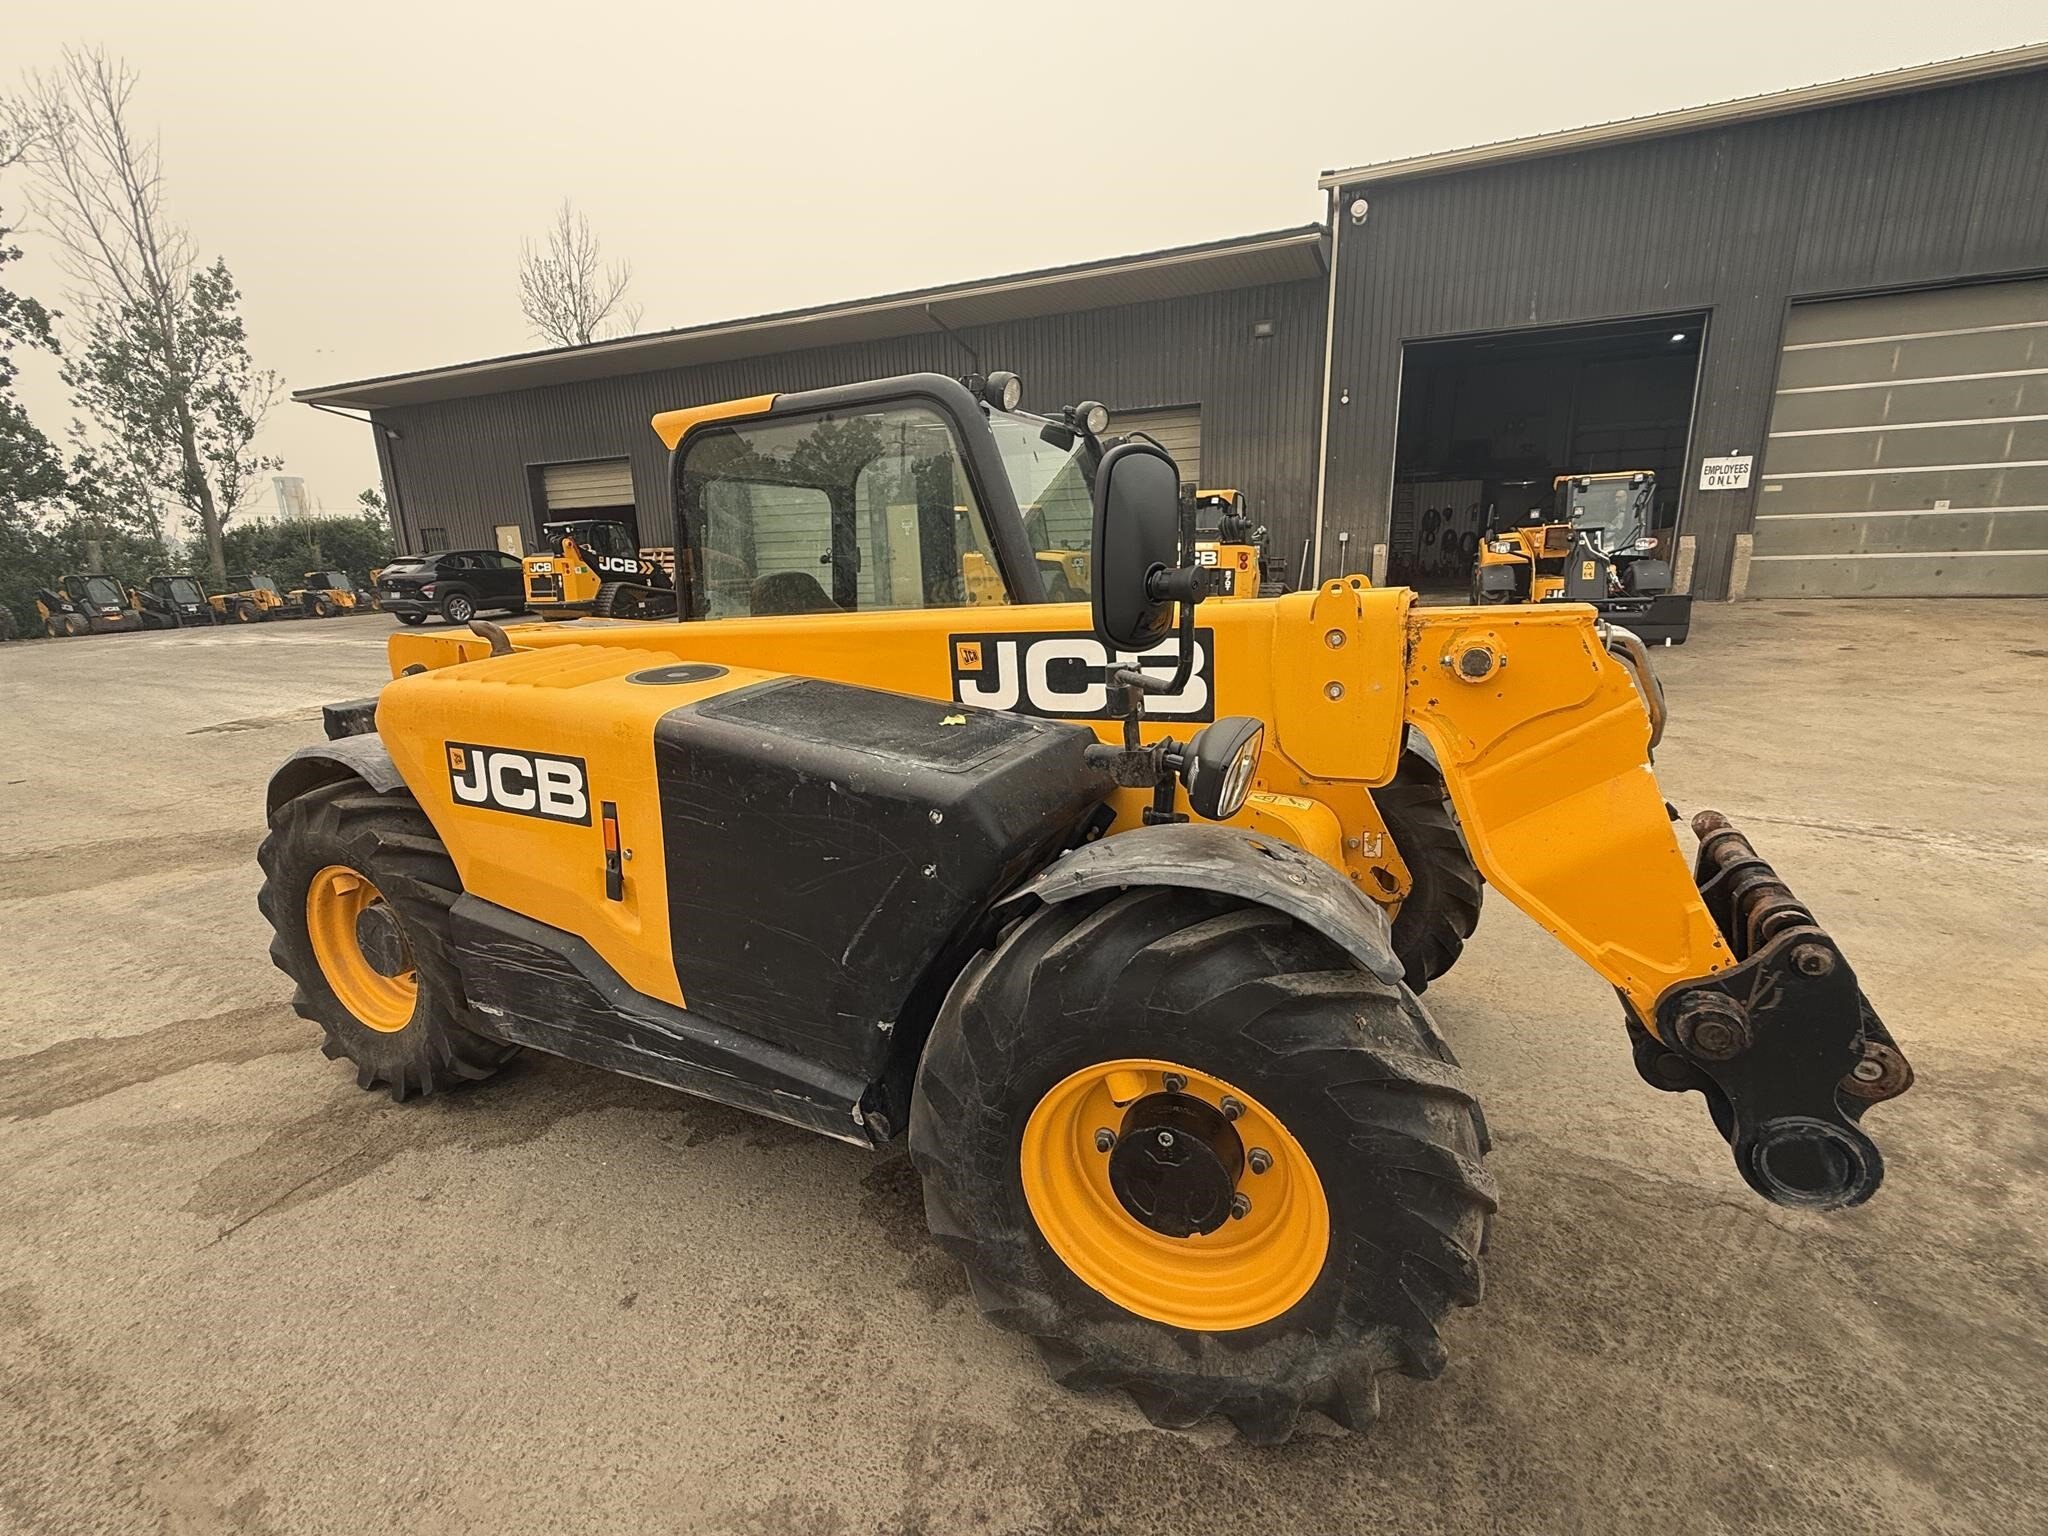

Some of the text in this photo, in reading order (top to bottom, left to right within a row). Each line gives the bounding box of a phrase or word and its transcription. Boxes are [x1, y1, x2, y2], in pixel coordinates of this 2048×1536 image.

[1704, 464, 1749, 475] EMPLOYEES
[1708, 475, 1740, 485] ONLY
[530, 562, 551, 572] JCB
[599, 556, 638, 573] JCB
[959, 638, 1208, 714] JCB
[453, 750, 587, 818] JCB
